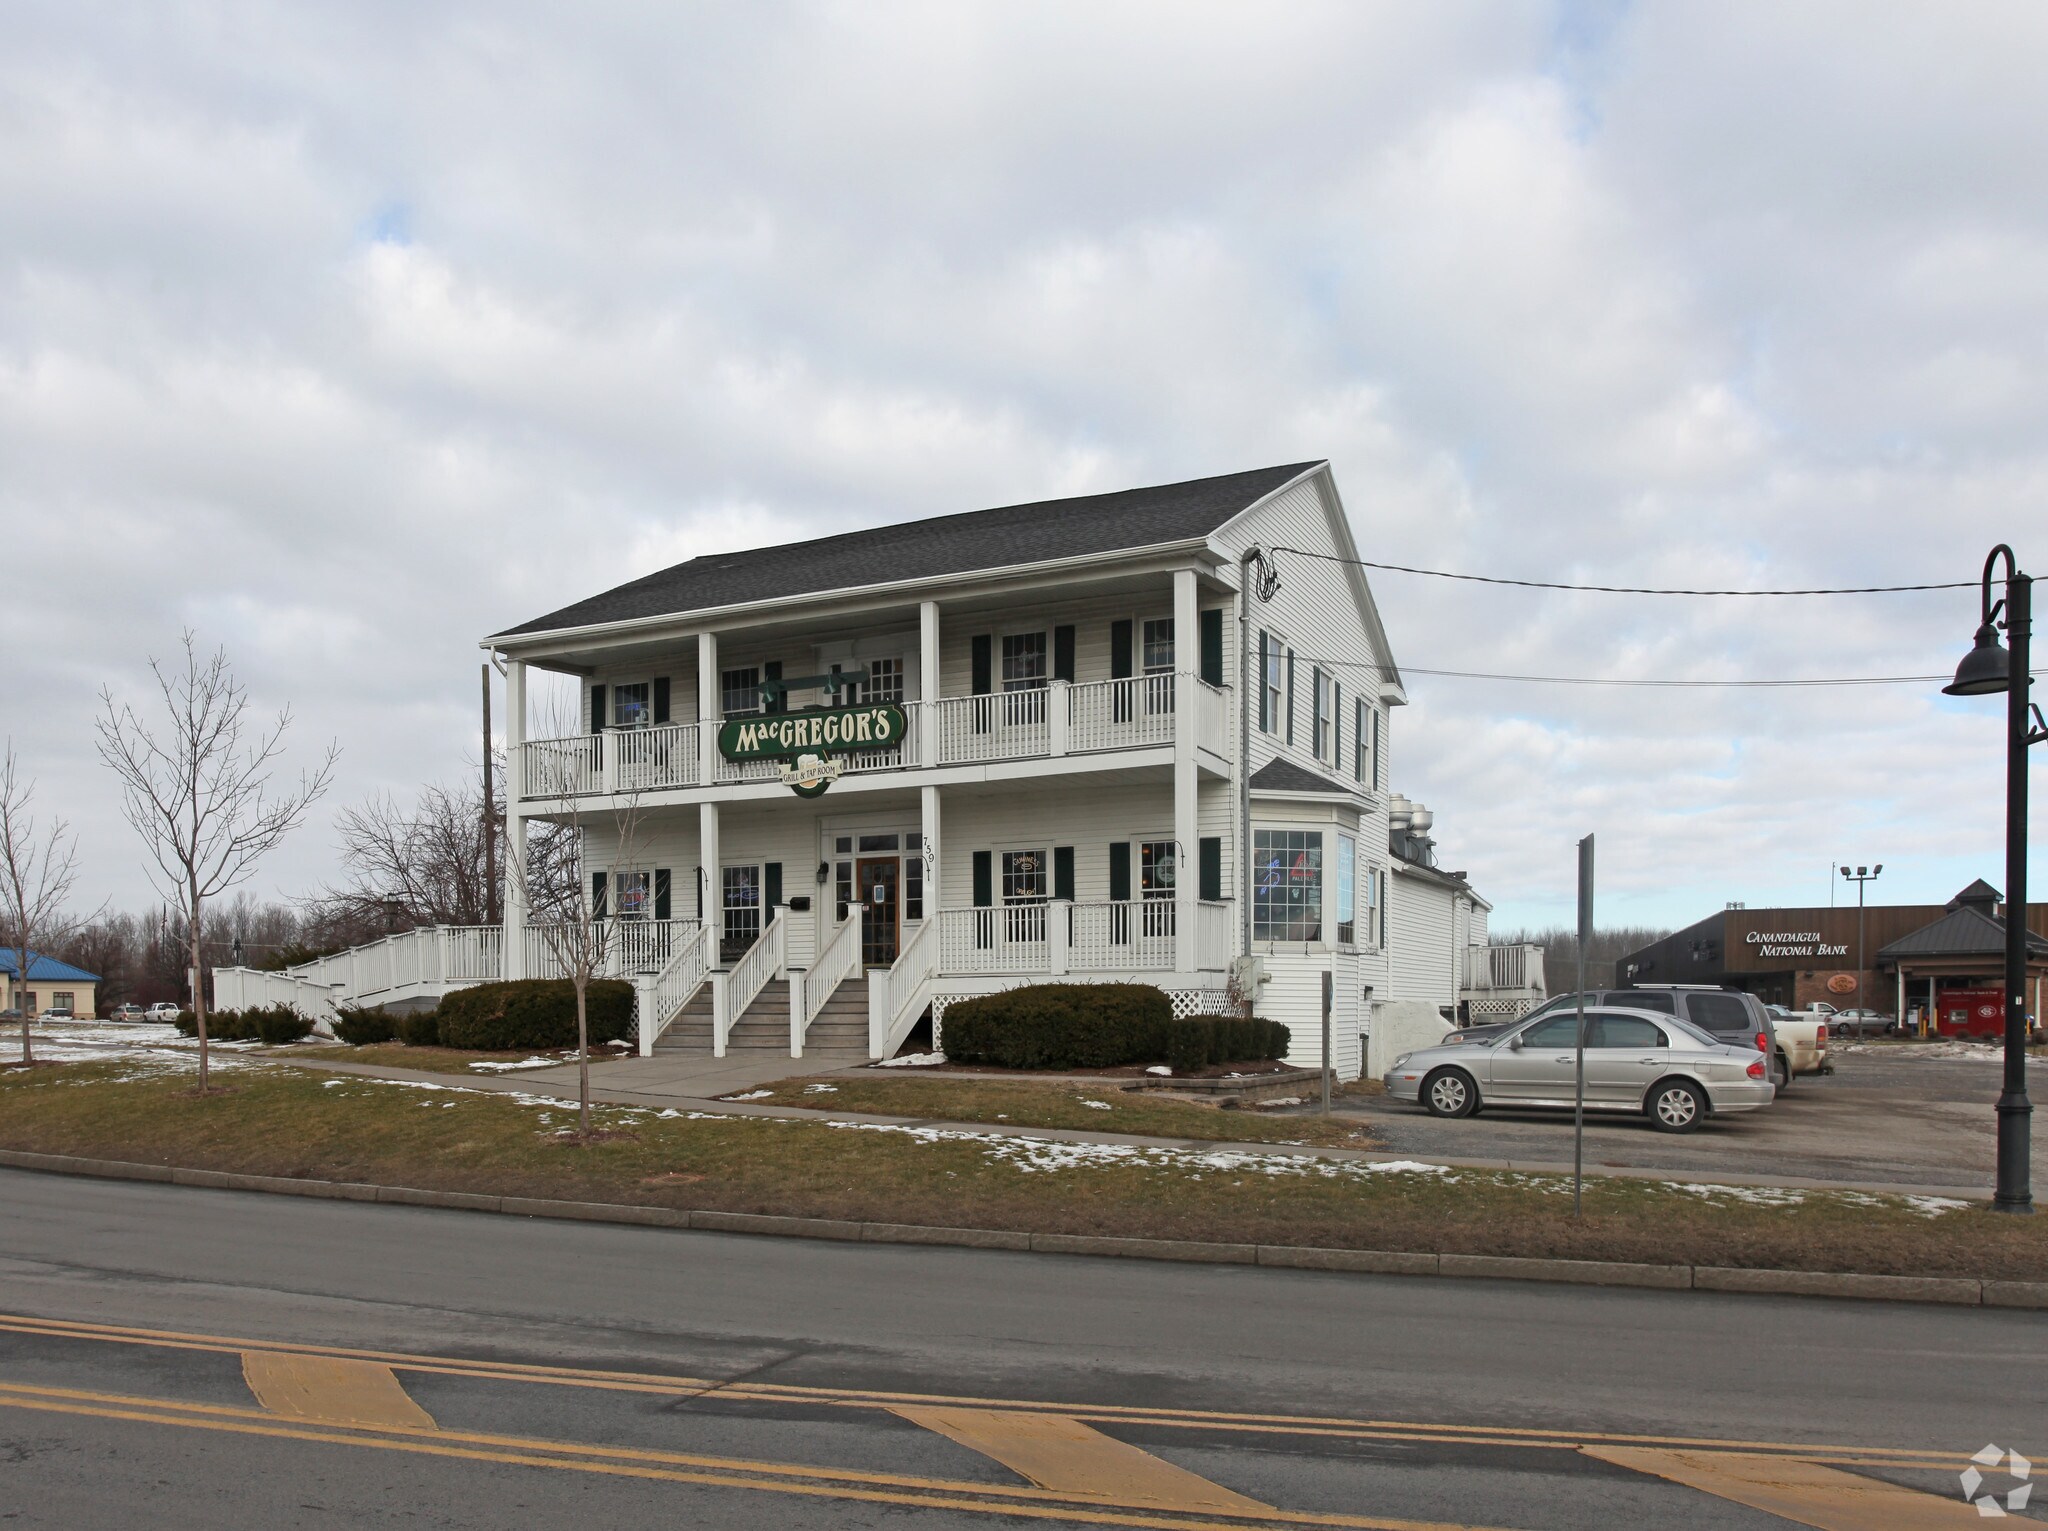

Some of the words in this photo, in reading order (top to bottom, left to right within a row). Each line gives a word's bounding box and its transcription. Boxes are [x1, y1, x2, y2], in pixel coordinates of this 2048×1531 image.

[735, 708, 891, 753] MacGREGOR'S
[783, 773, 799, 782] GRILL
[800, 771, 806, 780] &
[806, 768, 817, 778] TAP
[817, 766, 836, 776] ROOM
[1746, 931, 1821, 943] CANANDAIGUA
[1759, 944, 1813, 956] NATIONAL
[1816, 943, 1849, 955] BANK
